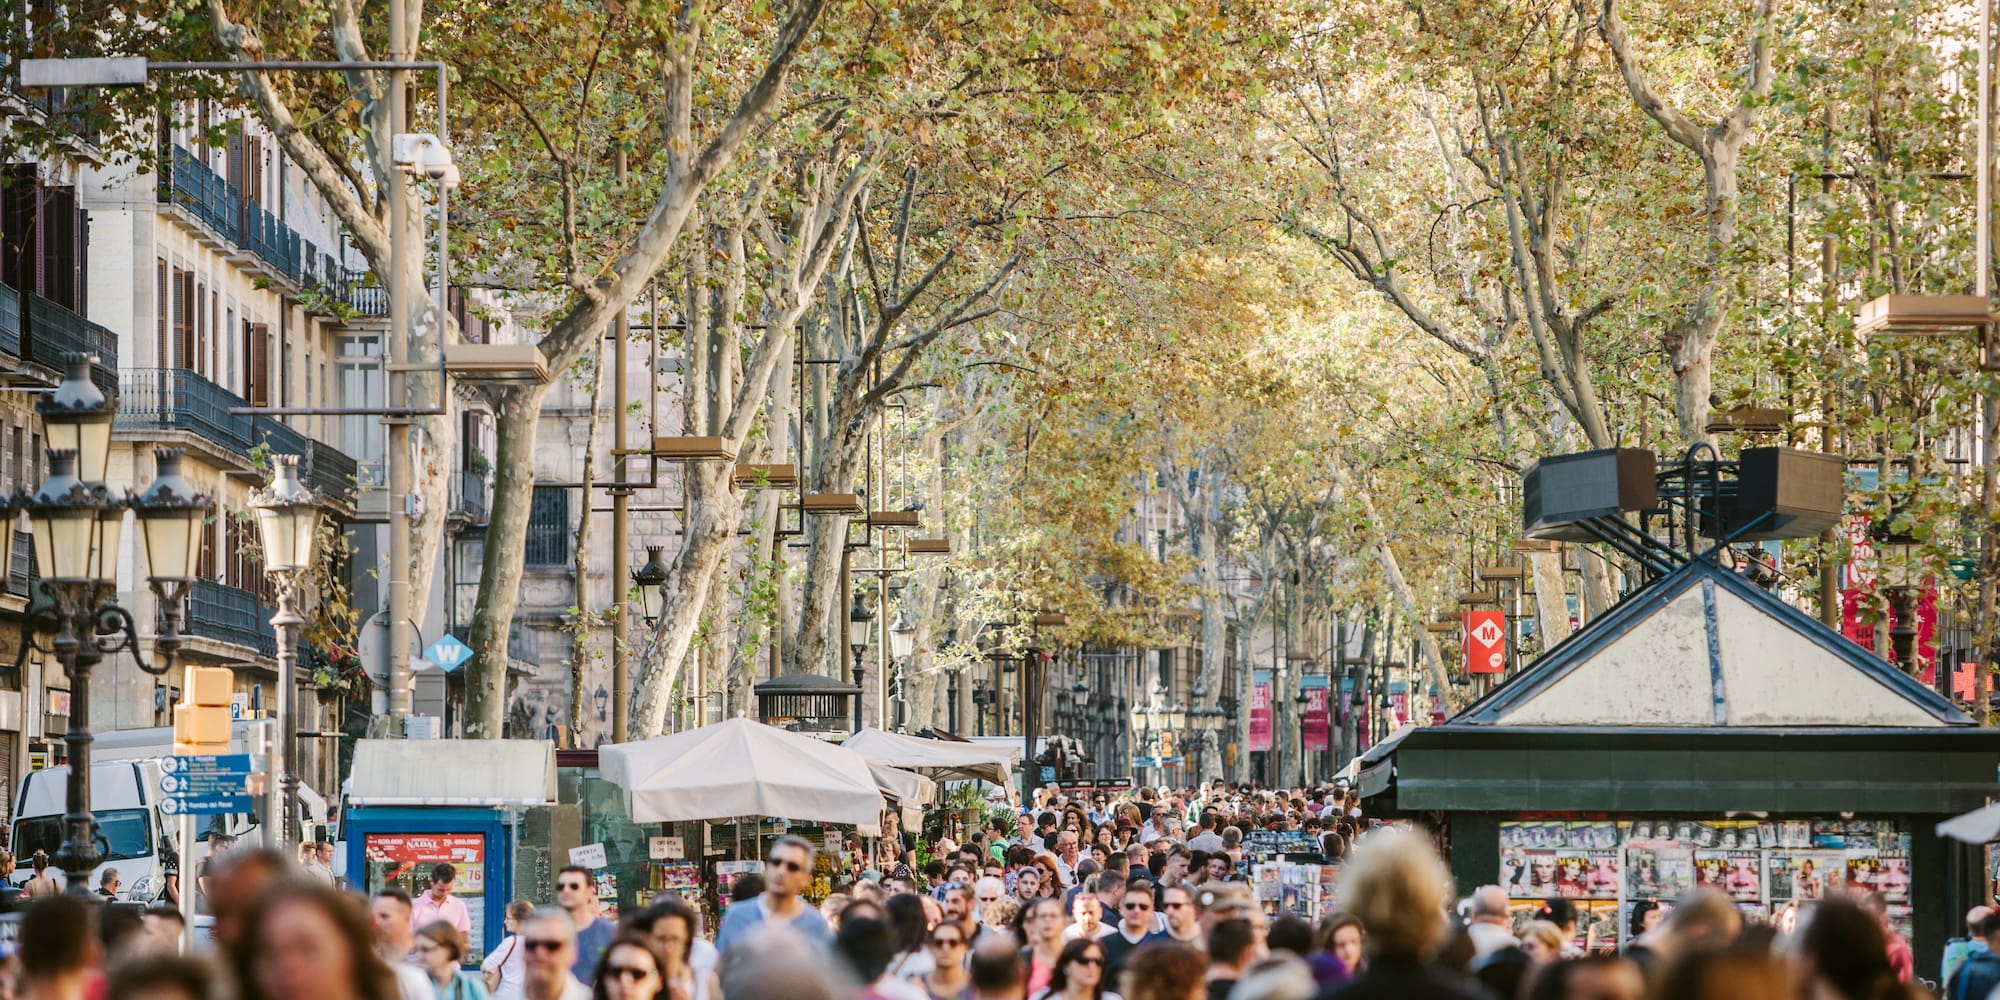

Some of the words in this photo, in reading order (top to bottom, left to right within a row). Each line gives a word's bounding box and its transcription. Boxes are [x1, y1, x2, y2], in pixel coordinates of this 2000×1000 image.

[1482, 626, 1496, 641] M
[435, 644, 461, 664] W
[232, 703, 238, 718] P
[406, 840, 440, 849] NADAL
[469, 870, 481, 881] 76
